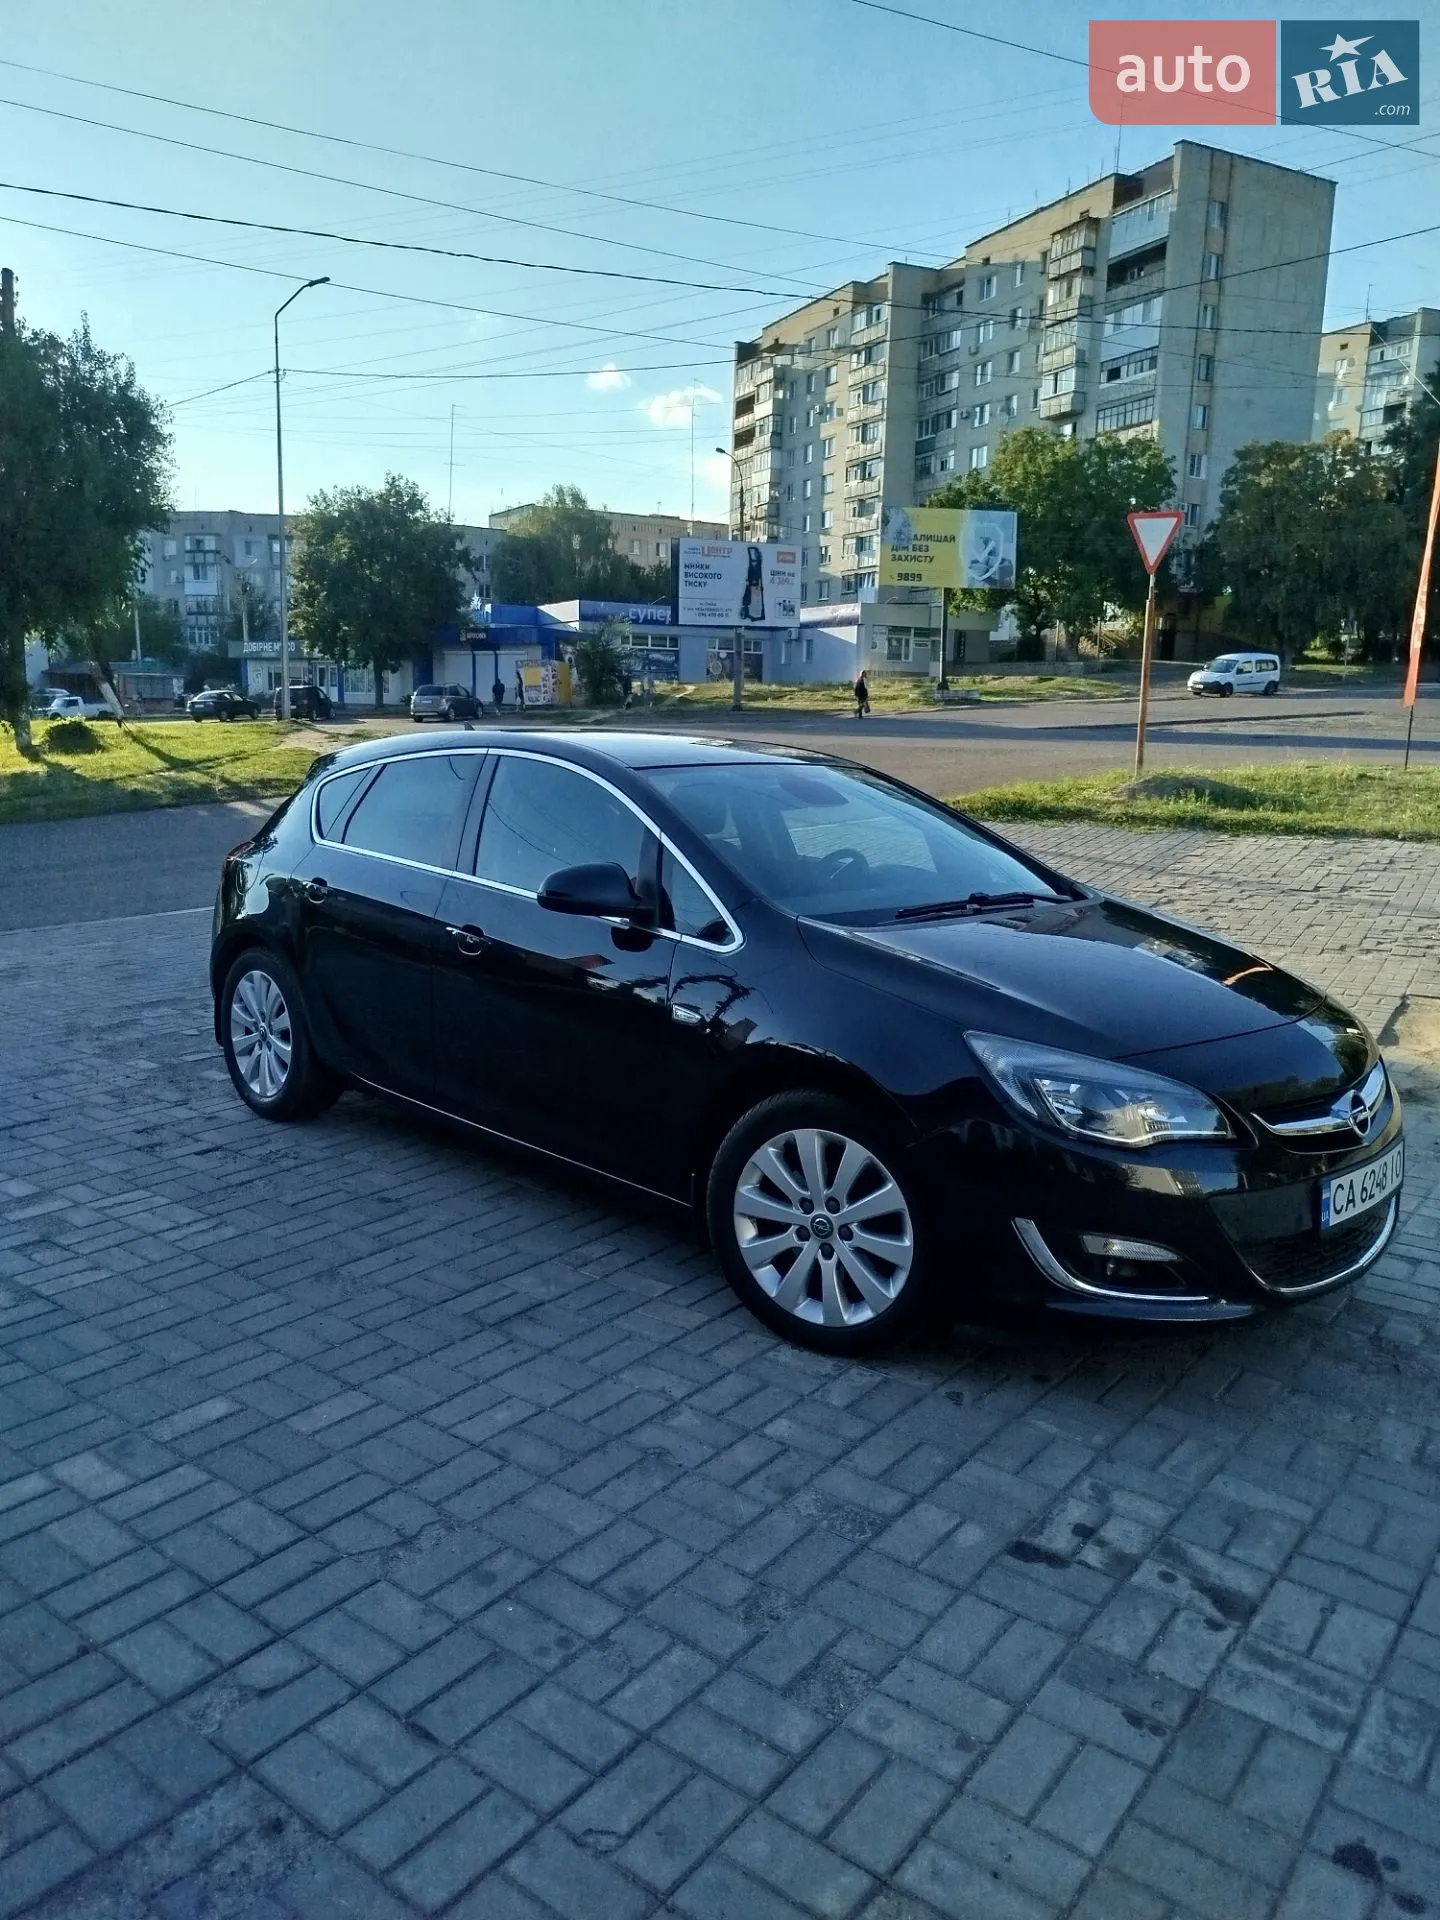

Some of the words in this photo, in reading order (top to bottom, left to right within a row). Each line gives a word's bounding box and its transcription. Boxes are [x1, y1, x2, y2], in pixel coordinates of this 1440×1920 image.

[912, 544, 930, 553] БЕЗ
[891, 553, 935, 564] ЗАХИСТУ
[684, 562, 710, 570] МИЙКИ
[684, 571, 722, 580] ВИСОКОГО
[897, 572, 923, 582] 9899
[684, 580, 708, 588] ТИСКУ
[243, 641, 273, 653] ДОБІРНЕ
[1333, 1179, 1356, 1215] CA
[1360, 1161, 1388, 1204] 6248
